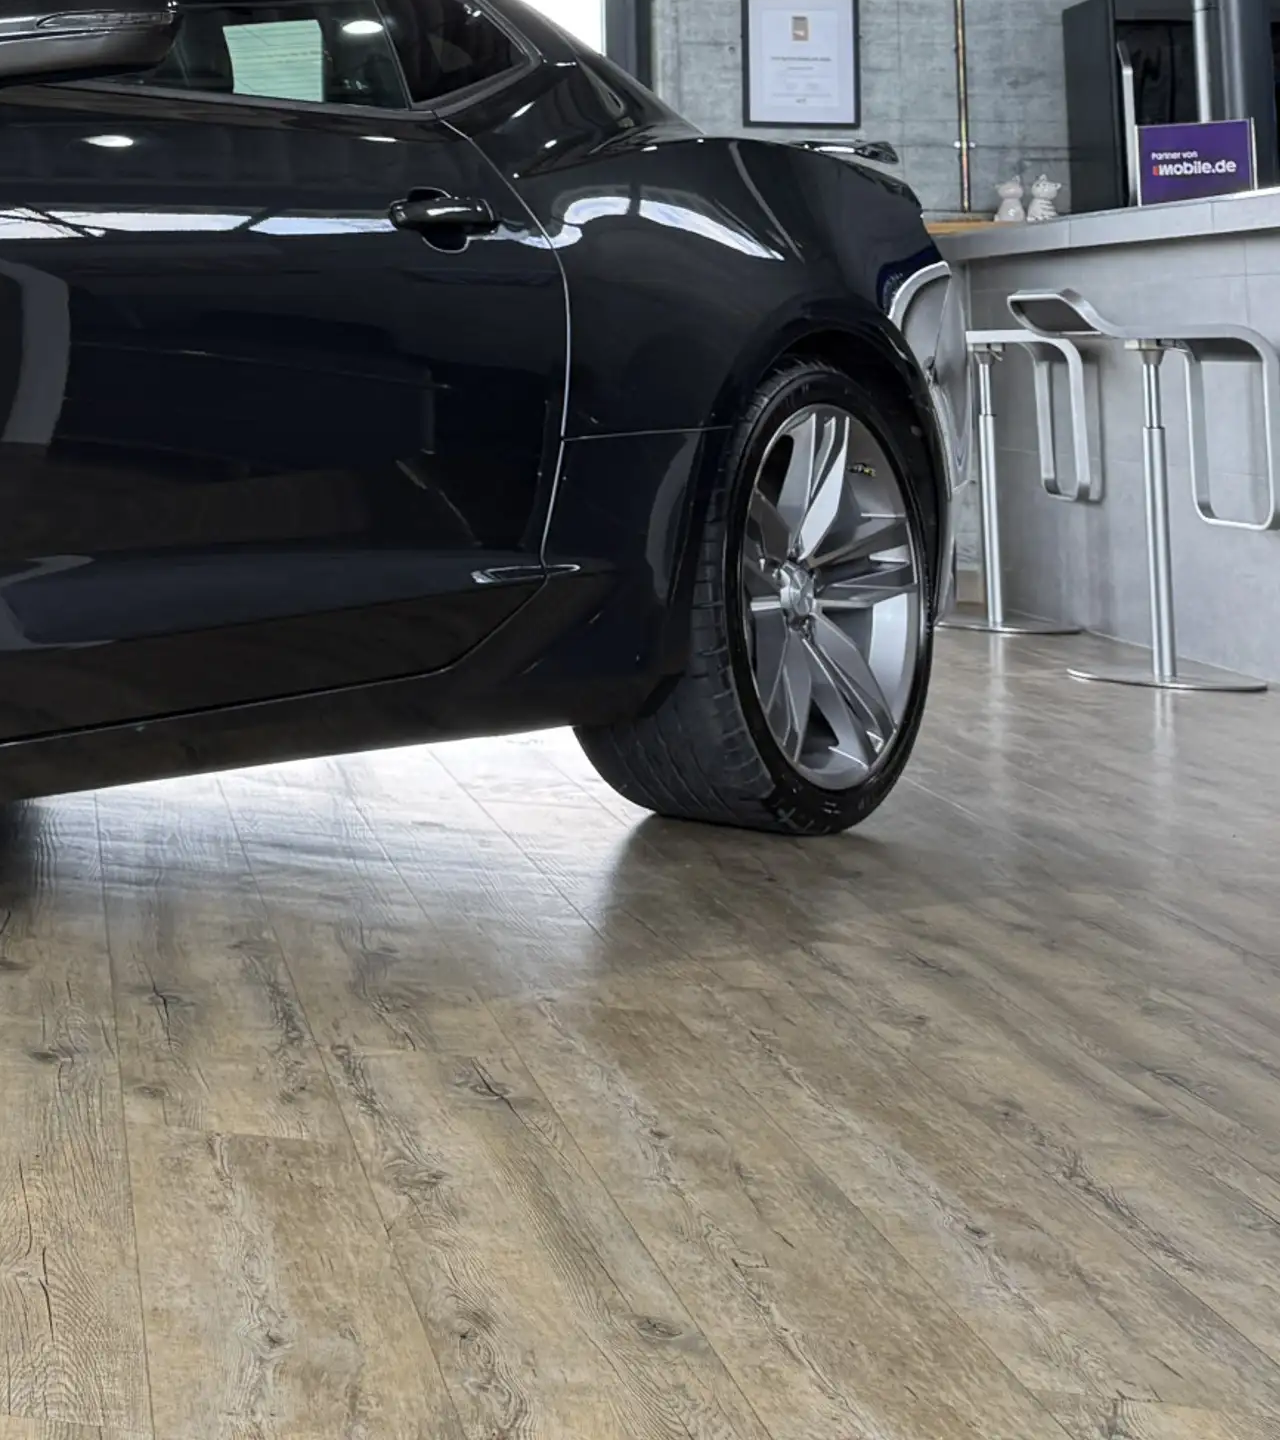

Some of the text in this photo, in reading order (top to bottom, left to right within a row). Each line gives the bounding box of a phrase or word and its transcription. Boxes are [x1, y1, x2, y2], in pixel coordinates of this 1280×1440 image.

[1150, 151, 1198, 160] Partner von
[1153, 160, 1237, 176] mobile.de
